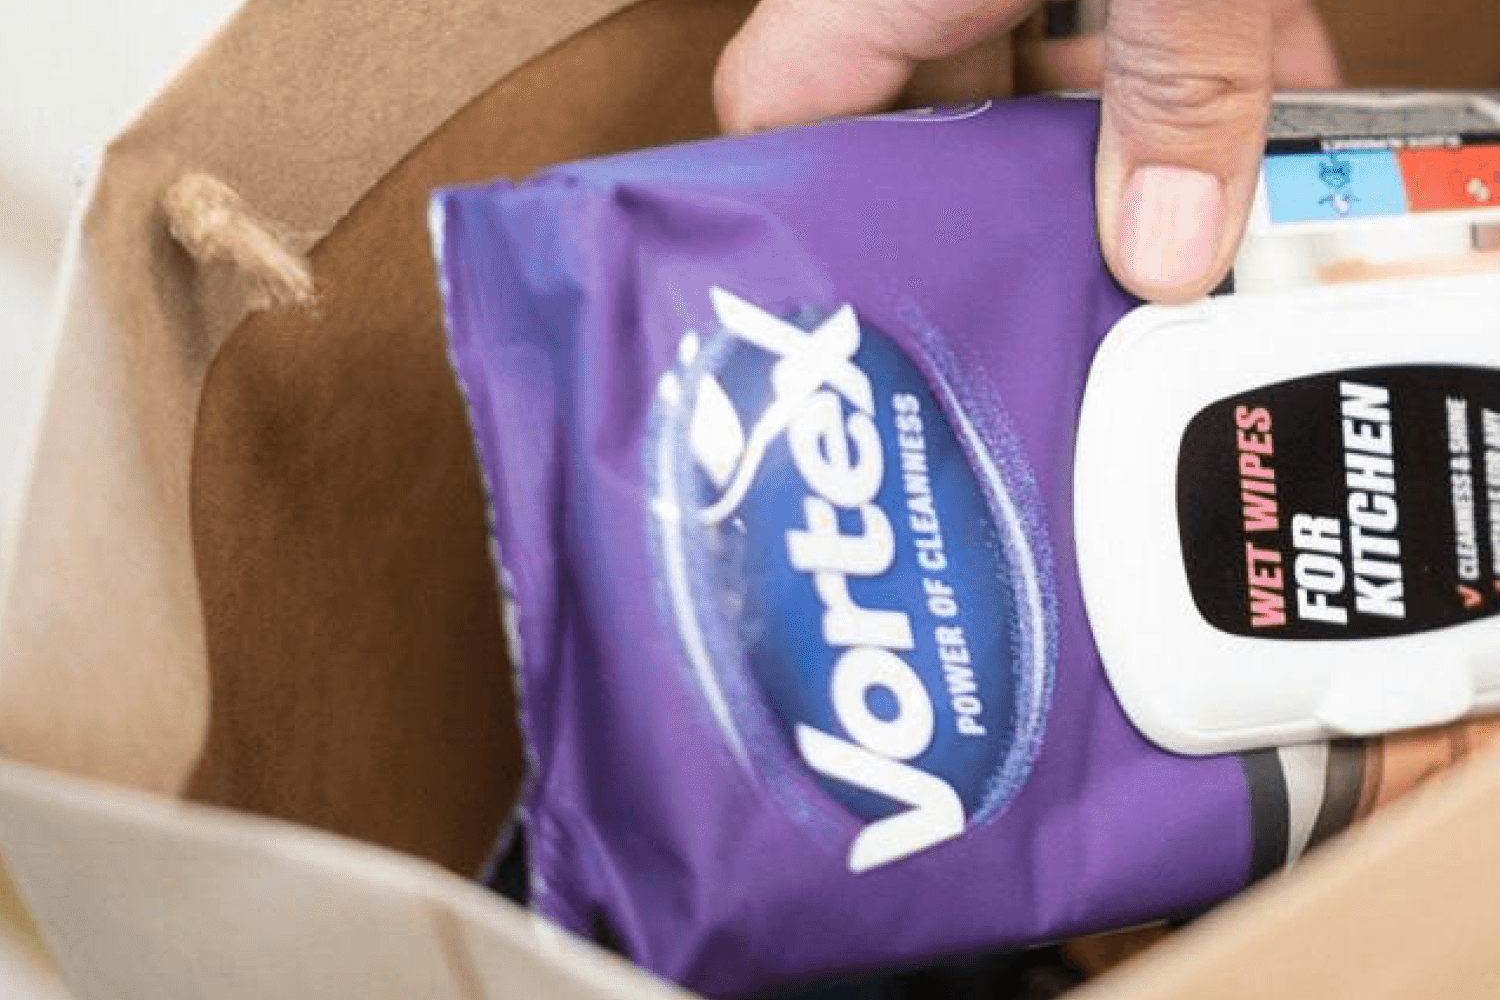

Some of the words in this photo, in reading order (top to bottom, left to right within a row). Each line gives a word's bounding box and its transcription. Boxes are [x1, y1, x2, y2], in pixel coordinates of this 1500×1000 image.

[1234, 405, 1280, 532] WIPES
[1445, 394, 1470, 453] SHINE
[892, 393, 948, 572] CLEANNESS
[1339, 379, 1406, 619] KITCHEN
[1451, 472, 1480, 580] CLEANNESS
[923, 577, 959, 618] OF
[1245, 541, 1286, 628] WET
[1292, 513, 1348, 626] FOR
[934, 625, 987, 736] POWER
